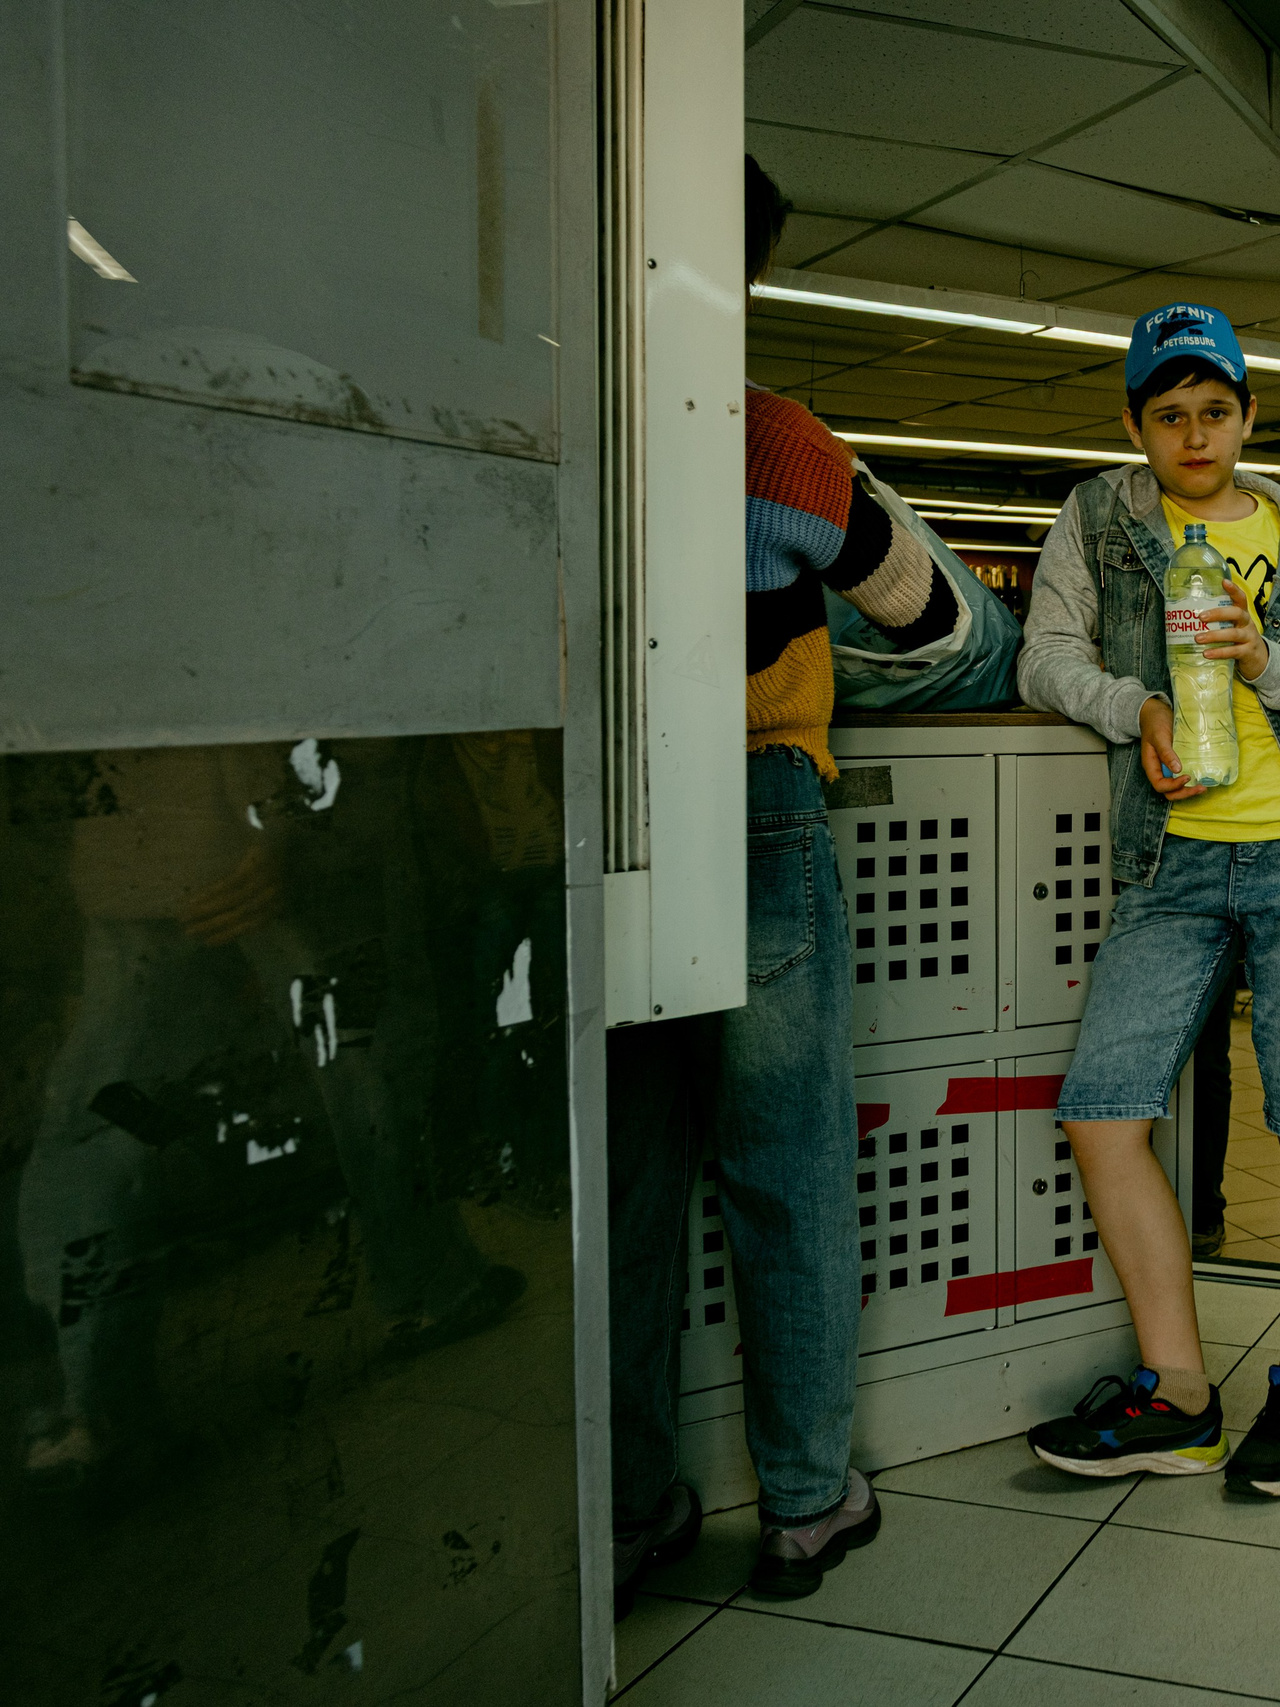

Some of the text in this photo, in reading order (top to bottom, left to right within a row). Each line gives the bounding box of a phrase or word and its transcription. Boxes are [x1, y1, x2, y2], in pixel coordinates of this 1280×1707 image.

[1146, 306, 1215, 333] FC ZENIT
[1164, 337, 1216, 348] PETERSBURG
